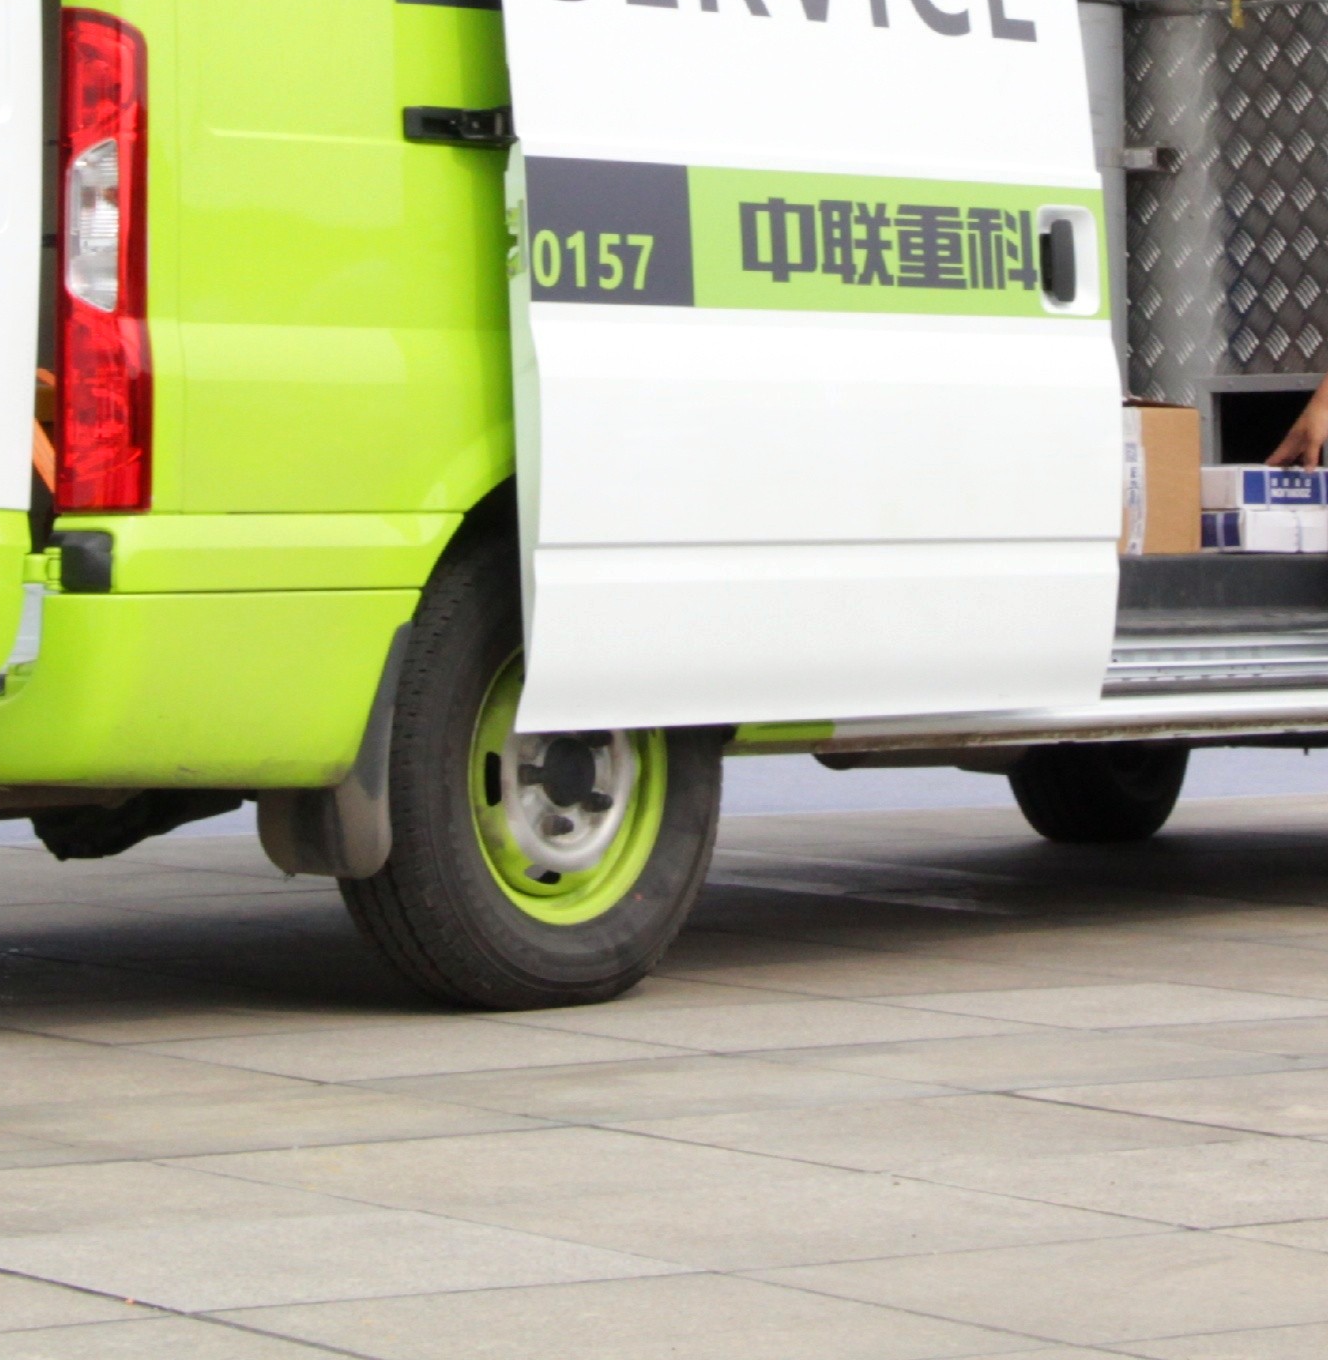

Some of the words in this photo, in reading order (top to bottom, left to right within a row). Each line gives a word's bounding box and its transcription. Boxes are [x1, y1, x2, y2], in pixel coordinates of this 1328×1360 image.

[532, 229, 654, 291] 0157
[738, 197, 1039, 291] 中联重科
